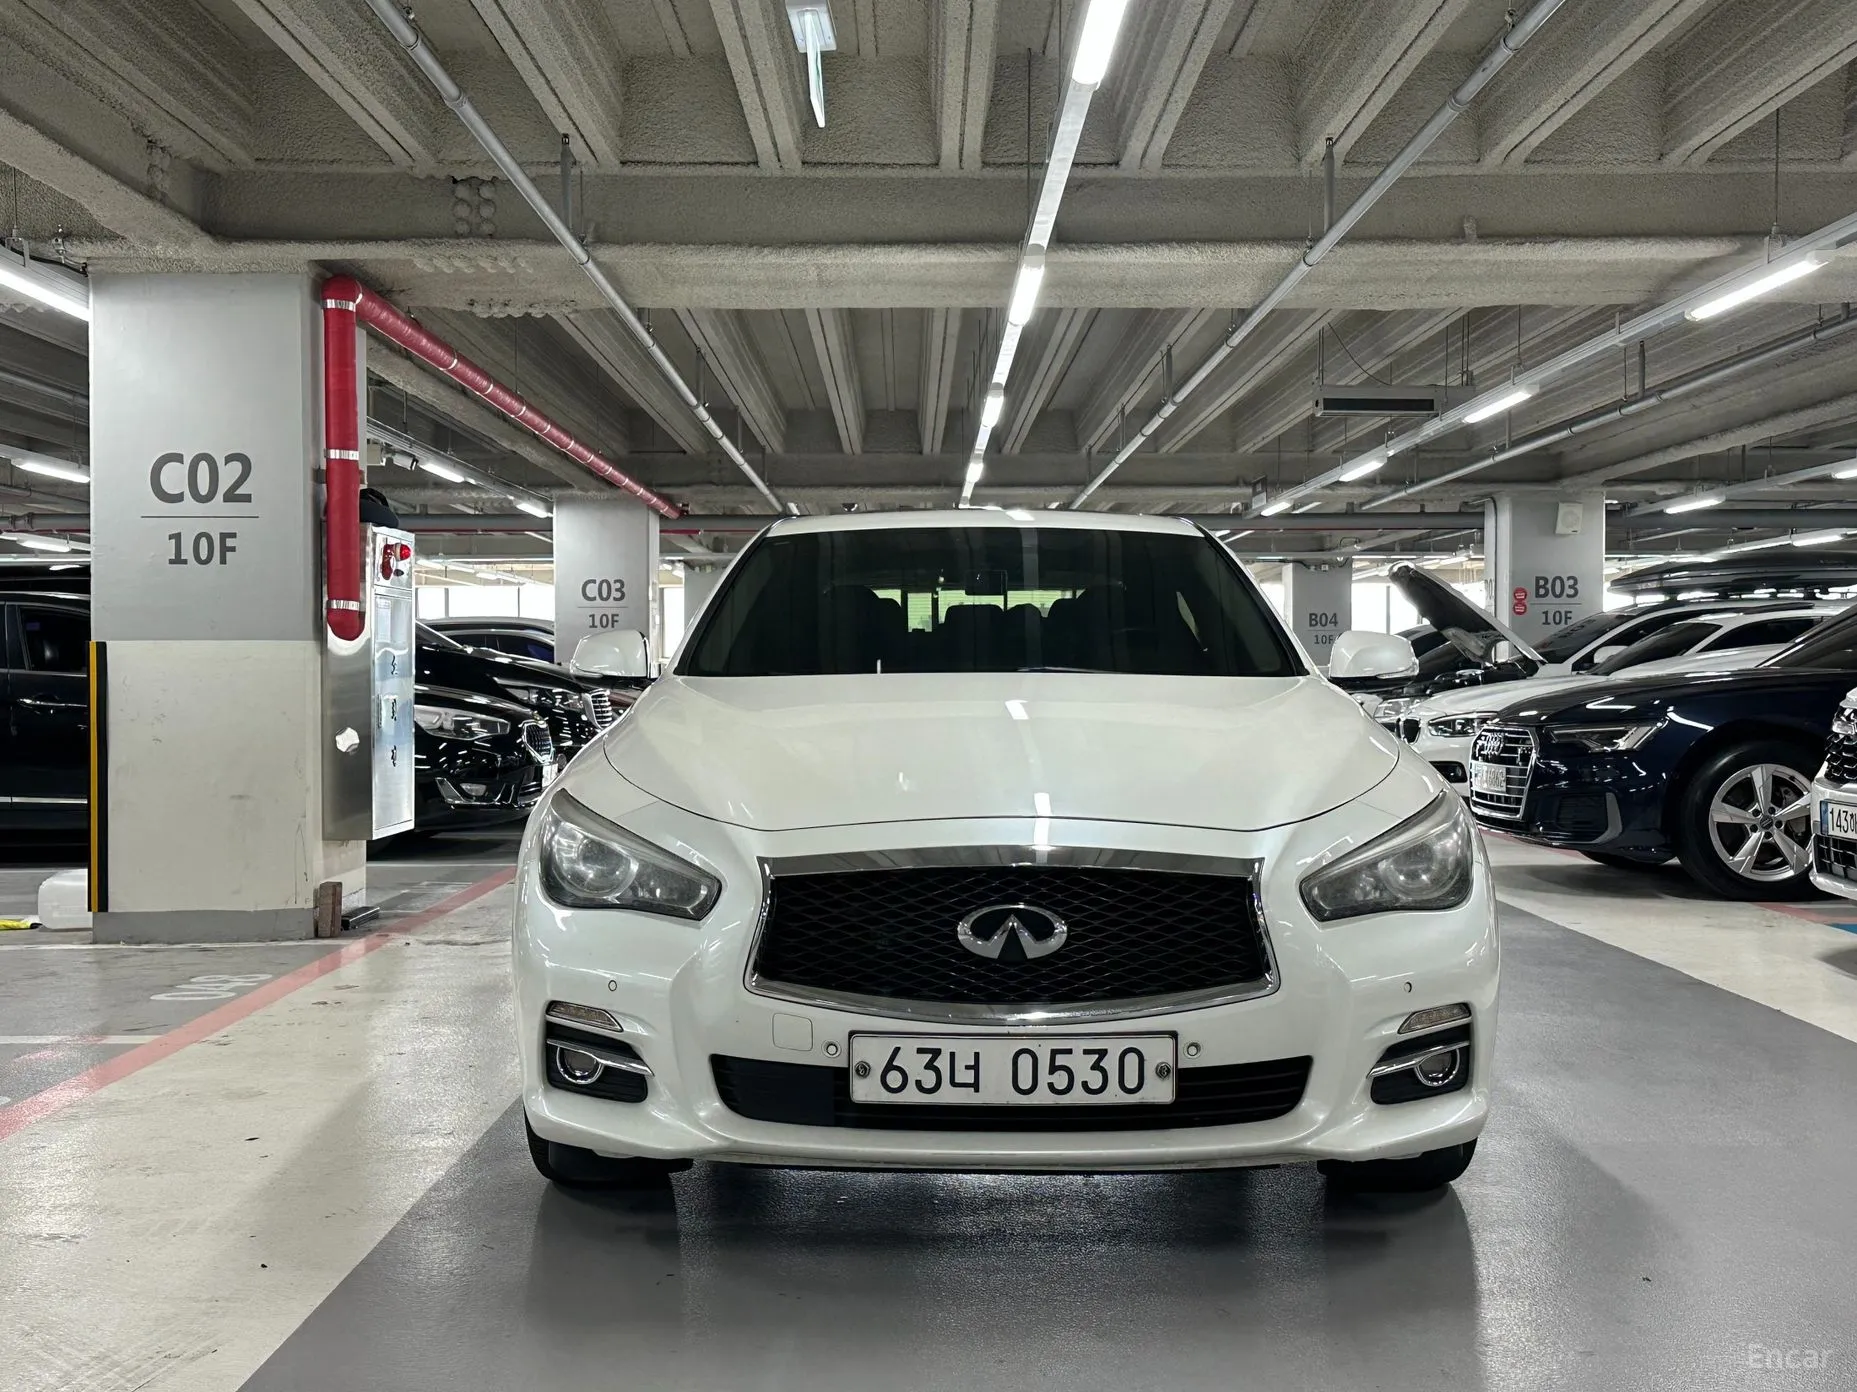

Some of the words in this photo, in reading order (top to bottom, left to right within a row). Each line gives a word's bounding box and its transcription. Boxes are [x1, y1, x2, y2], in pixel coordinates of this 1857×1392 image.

[149, 451, 253, 504] C02
[167, 531, 238, 566] 10F
[581, 578, 626, 602] C03
[1534, 575, 1579, 599] B03
[588, 613, 620, 629] 10F
[1308, 612, 1339, 628] B04
[1541, 610, 1573, 626] 10F
[1314, 634, 1334, 645] 10F
[880, 1046, 980, 1094] 63너
[1011, 1047, 1145, 1096] 0530
